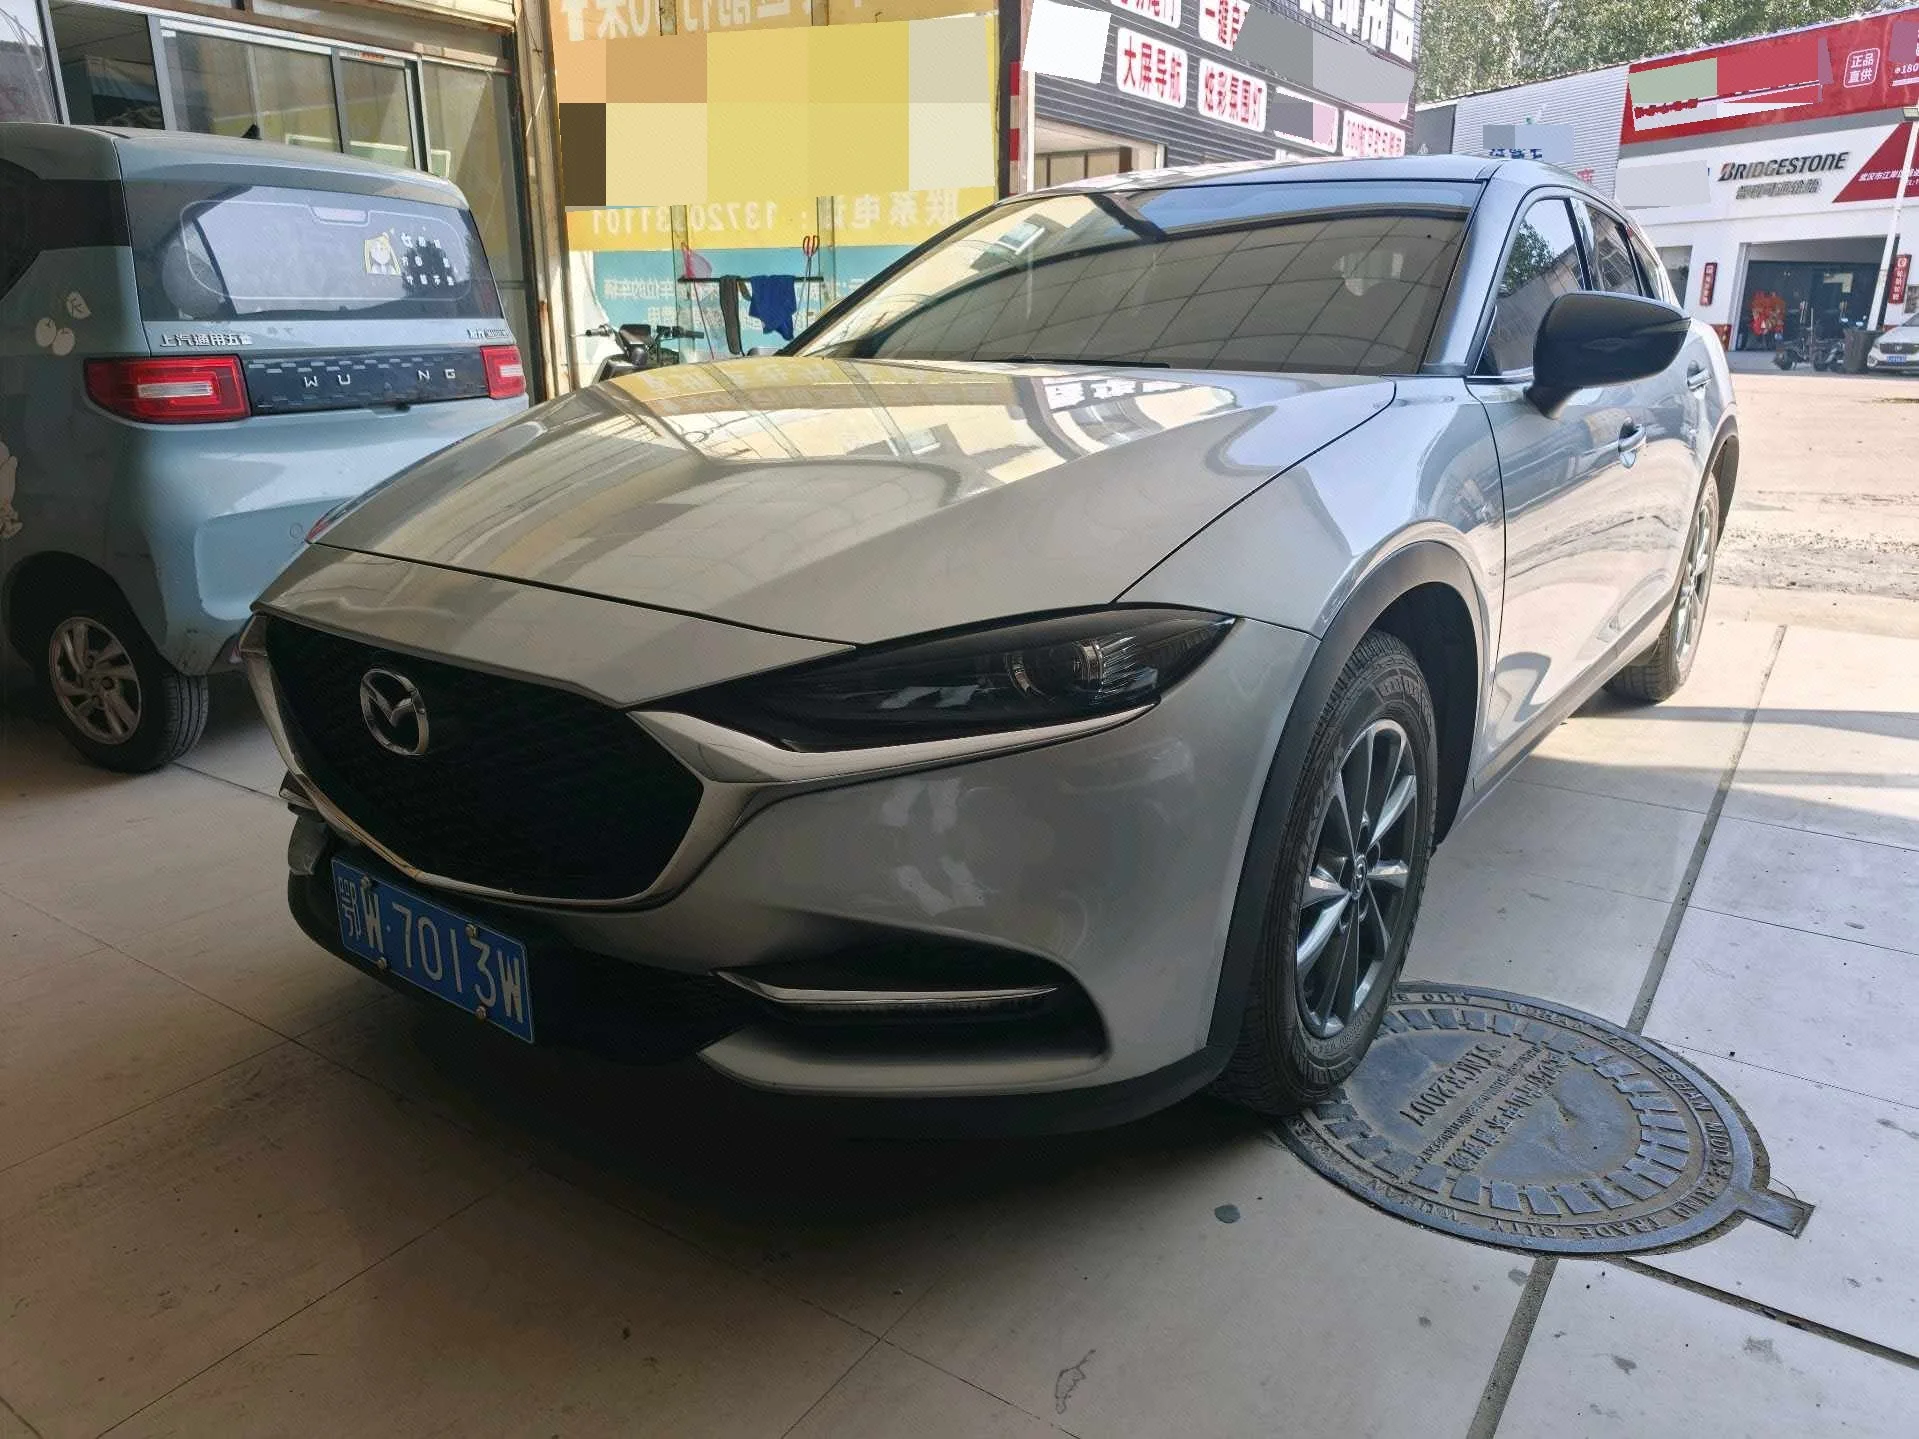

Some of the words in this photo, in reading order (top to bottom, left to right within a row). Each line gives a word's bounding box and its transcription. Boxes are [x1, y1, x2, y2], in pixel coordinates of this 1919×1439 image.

[1204, 0, 1248, 46] 一键启
[1123, 36, 1182, 104] 大屏导航
[1847, 67, 1873, 84] 直供
[1850, 52, 1875, 69] 正品
[1717, 151, 1850, 182] BRIDGESTONE
